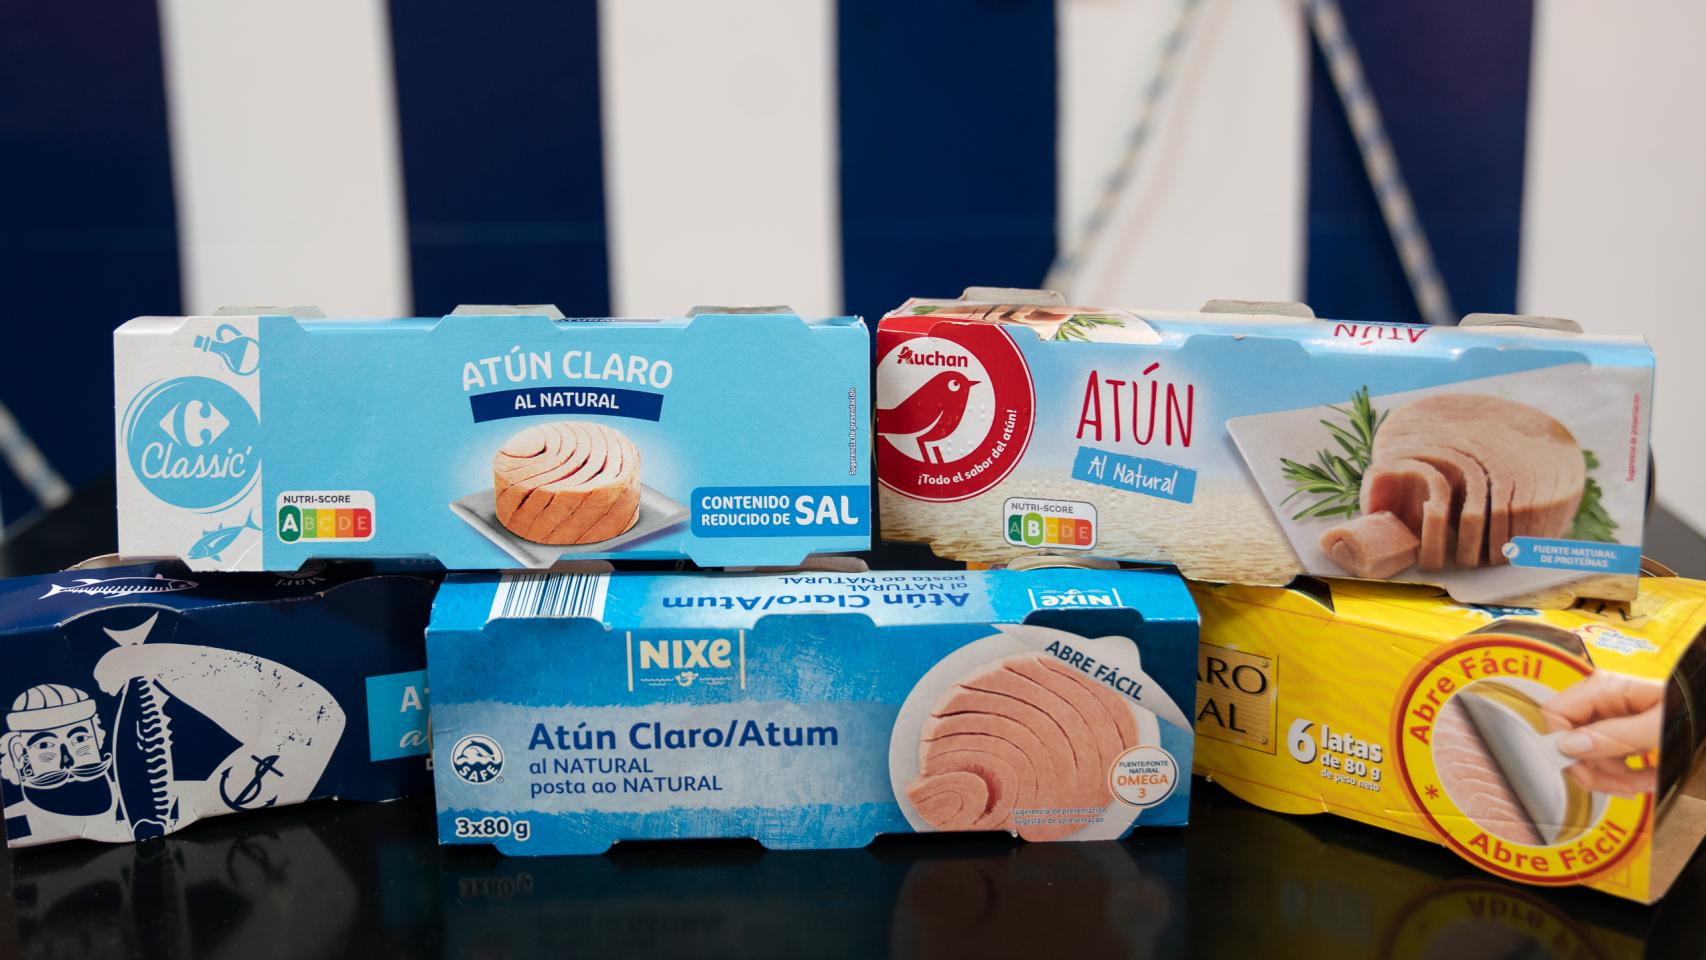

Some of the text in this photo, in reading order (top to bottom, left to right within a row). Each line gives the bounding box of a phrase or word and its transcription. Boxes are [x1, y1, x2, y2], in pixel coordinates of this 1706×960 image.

[1334, 323, 1427, 346] ATÚN
[897, 346, 968, 368] Auchan
[462, 345, 673, 391] ATÚN CLARO
[514, 392, 619, 410] AL NATURAL
[1076, 362, 1194, 448] ATÚN
[918, 409, 1018, 485] ¡Todo el sabor del atún!
[1087, 455, 1179, 495] Al Natural
[283, 495, 351, 504] NUTRI-SCORE
[1011, 502, 1074, 514] NUTRI-SCORE
[701, 495, 859, 526] CONTENIDO SAL
[701, 513, 791, 526] REDUCIDO DE
[1533, 544, 1617, 559] FUENTE NATURAL
[1540, 555, 1553, 564] DE
[778, 576, 876, 586] NATURAL
[846, 583, 944, 592] NATURAL
[661, 592, 970, 610] Atún Claro/Atum
[1045, 640, 1143, 700] ABRE FÁCIL
[1197, 655, 1267, 695] RO
[1409, 651, 1543, 746] Abre Fácil
[528, 718, 839, 751] Atún Claro/Atum
[1287, 717, 1384, 765] 6 latas
[459, 764, 498, 782] SAFE
[529, 757, 654, 775] al NATURAL
[1128, 767, 1159, 775] NATURAL
[1321, 751, 1382, 782] de 80 g
[531, 776, 723, 799] posta ao NATURAL
[1116, 774, 1169, 786] OMEGA
[1138, 787, 1147, 799] 3
[513, 820, 530, 841] g
[1468, 819, 1628, 872] Abre Fácil
